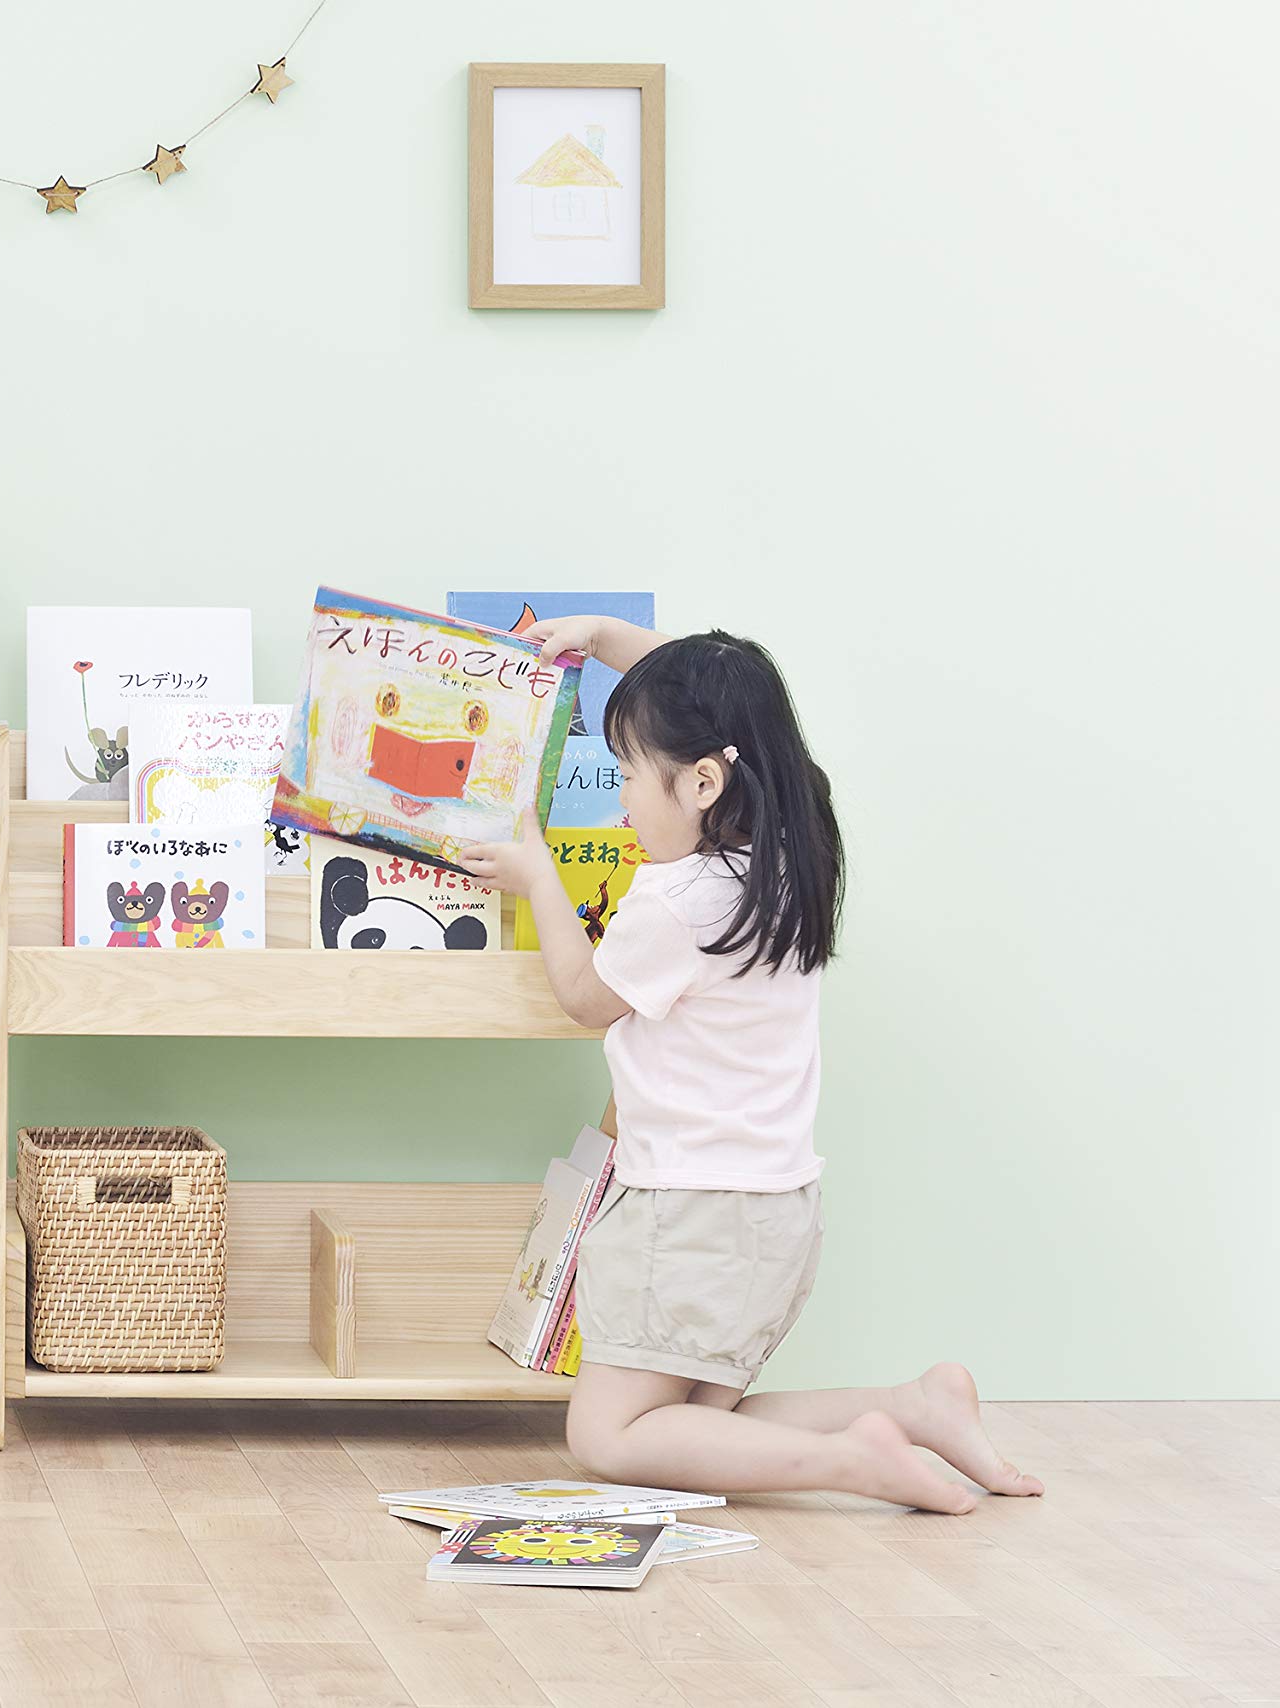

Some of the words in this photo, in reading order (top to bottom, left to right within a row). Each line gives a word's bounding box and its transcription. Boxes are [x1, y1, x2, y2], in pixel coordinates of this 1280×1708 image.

[318, 616, 556, 698] えほんのこども
[118, 671, 208, 690] フレデリック
[178, 732, 286, 751] パンやさん
[107, 840, 228, 857] ぼくのいろなあに
[553, 842, 652, 865] とまねこ
[437, 903, 460, 911] MAYA
